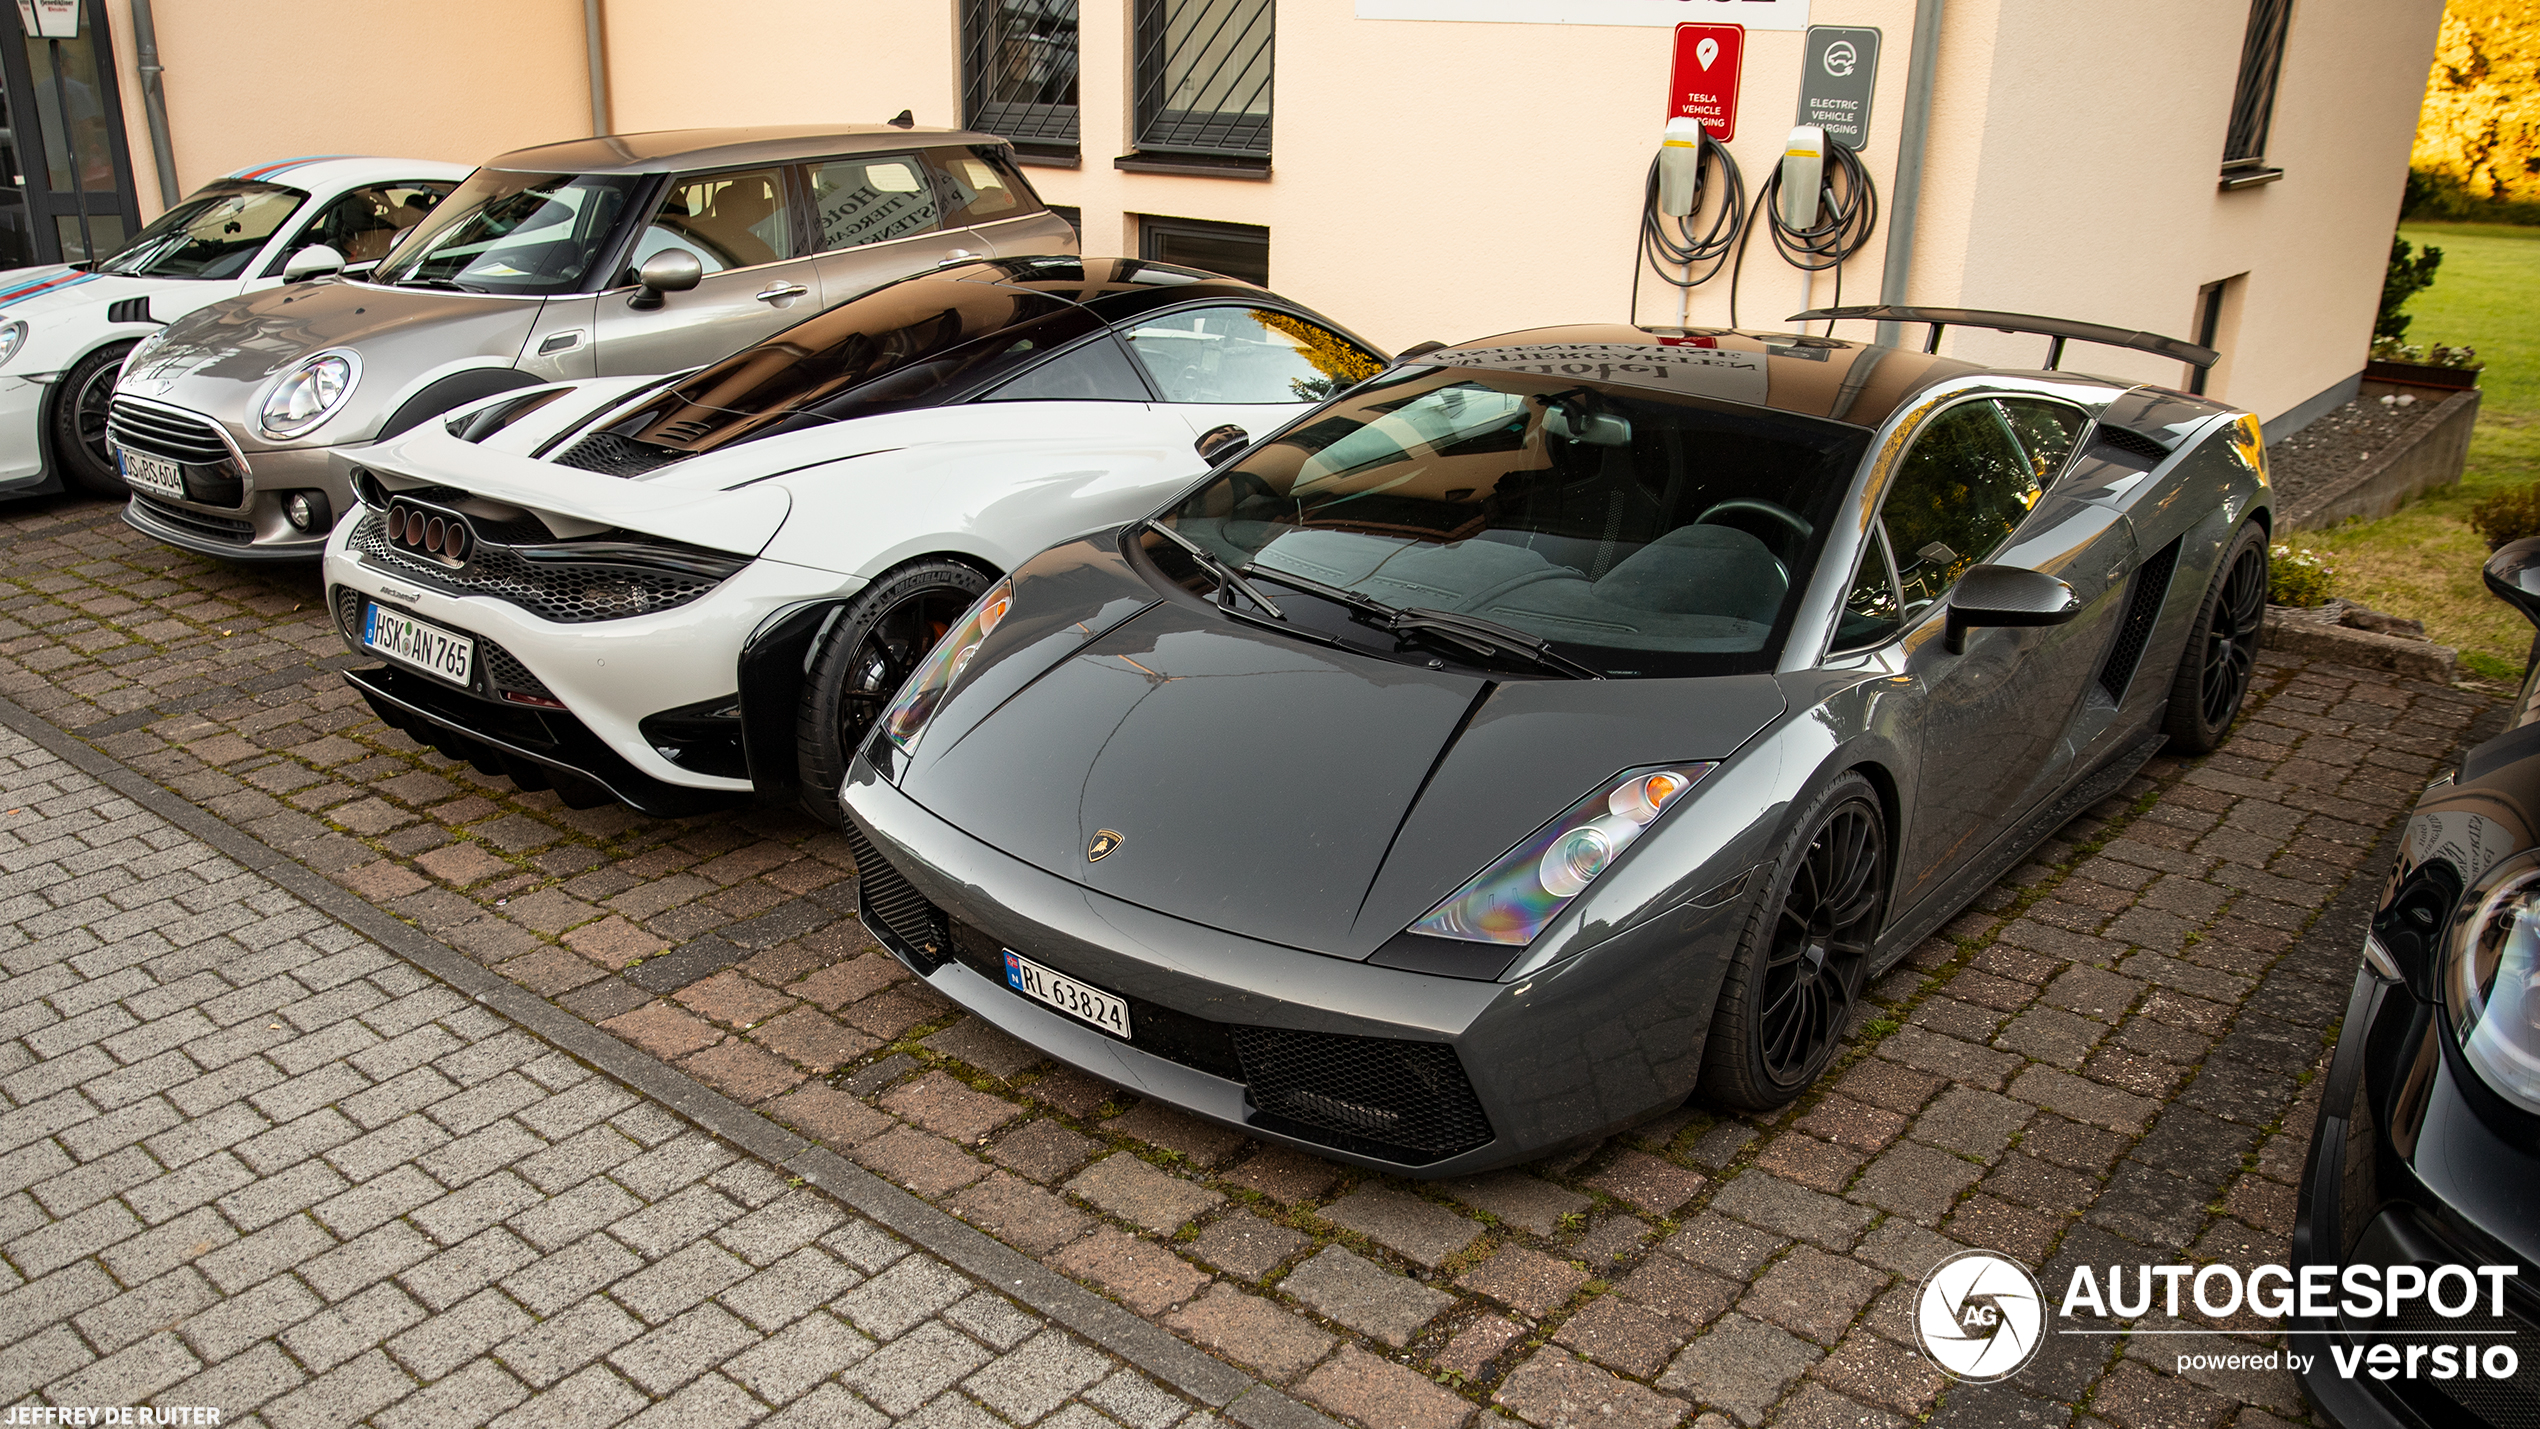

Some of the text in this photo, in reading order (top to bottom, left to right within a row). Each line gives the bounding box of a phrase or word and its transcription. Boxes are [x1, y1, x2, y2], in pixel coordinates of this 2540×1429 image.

[1688, 93, 1718, 103] TESLA
[1810, 98, 1859, 110] ELECTRIC
[1682, 104, 1721, 115] VEHICLE
[1811, 110, 1854, 122] VEHICLE
[141, 459, 158, 484] BS
[159, 464, 182, 491] 604
[894, 569, 952, 595] MICHELIN
[374, 612, 468, 677] HSK AN 765
[1011, 973, 1019, 984] N
[1022, 965, 1123, 1031] RL 63824
